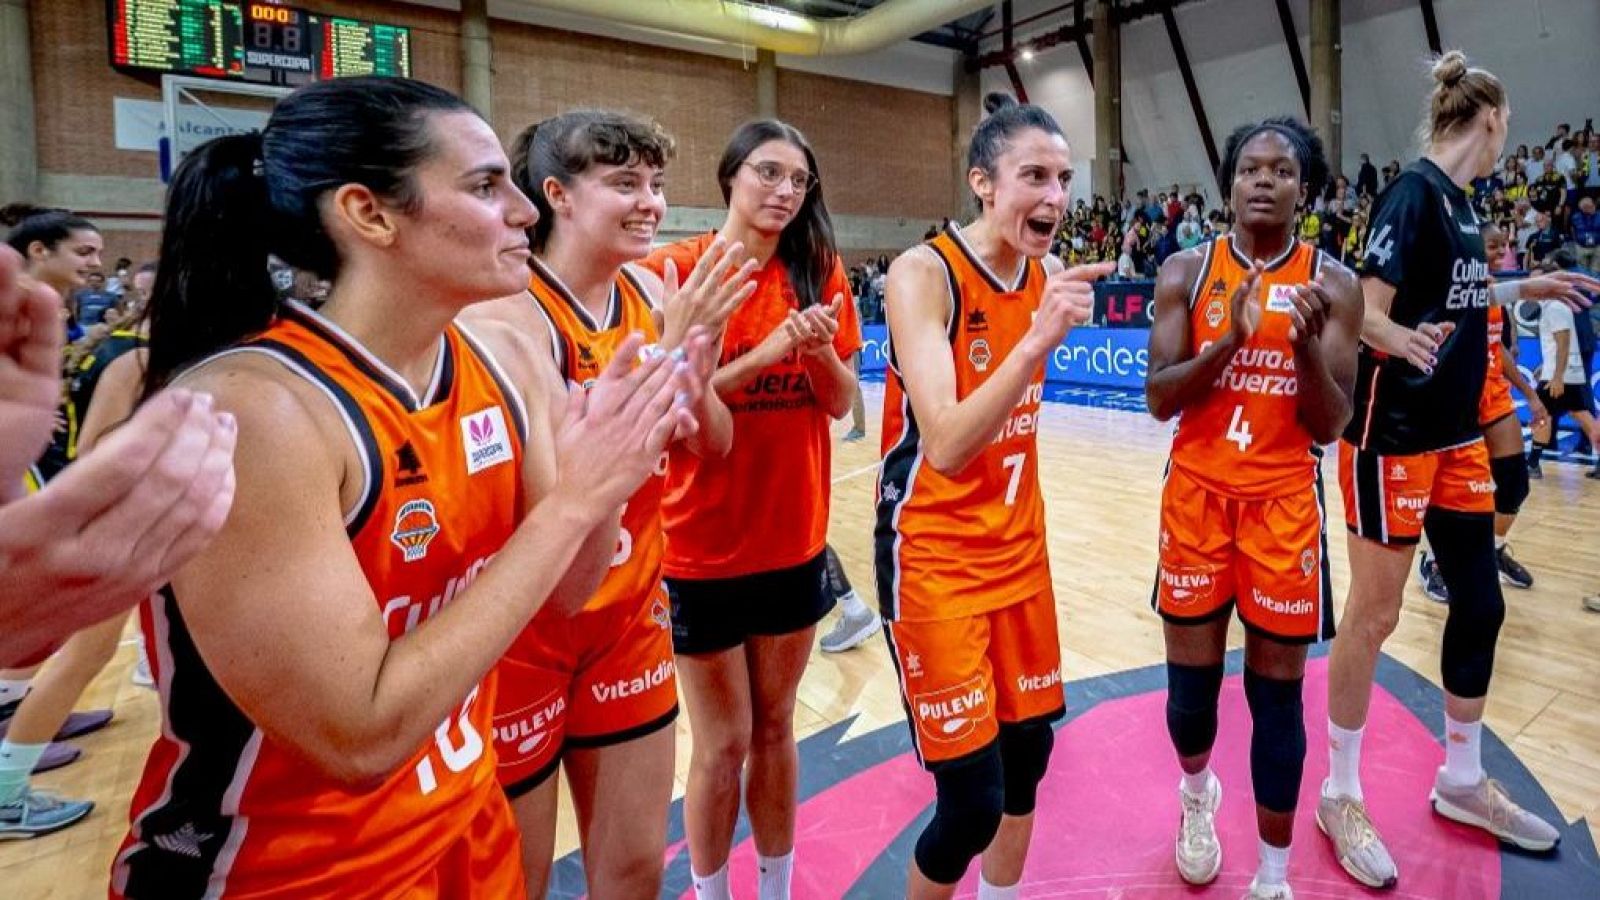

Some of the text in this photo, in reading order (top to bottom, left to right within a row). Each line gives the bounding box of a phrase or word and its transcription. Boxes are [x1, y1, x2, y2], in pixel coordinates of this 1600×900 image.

[247, 51, 310, 70] SUPERCOPA
[1107, 294, 1143, 322] LF
[1213, 365, 1298, 396] fuerzo
[1226, 404, 1253, 452] 4
[1003, 453, 1026, 506] 7
[1252, 587, 1314, 616] Vitaldin
[918, 688, 985, 721] PULEVA
